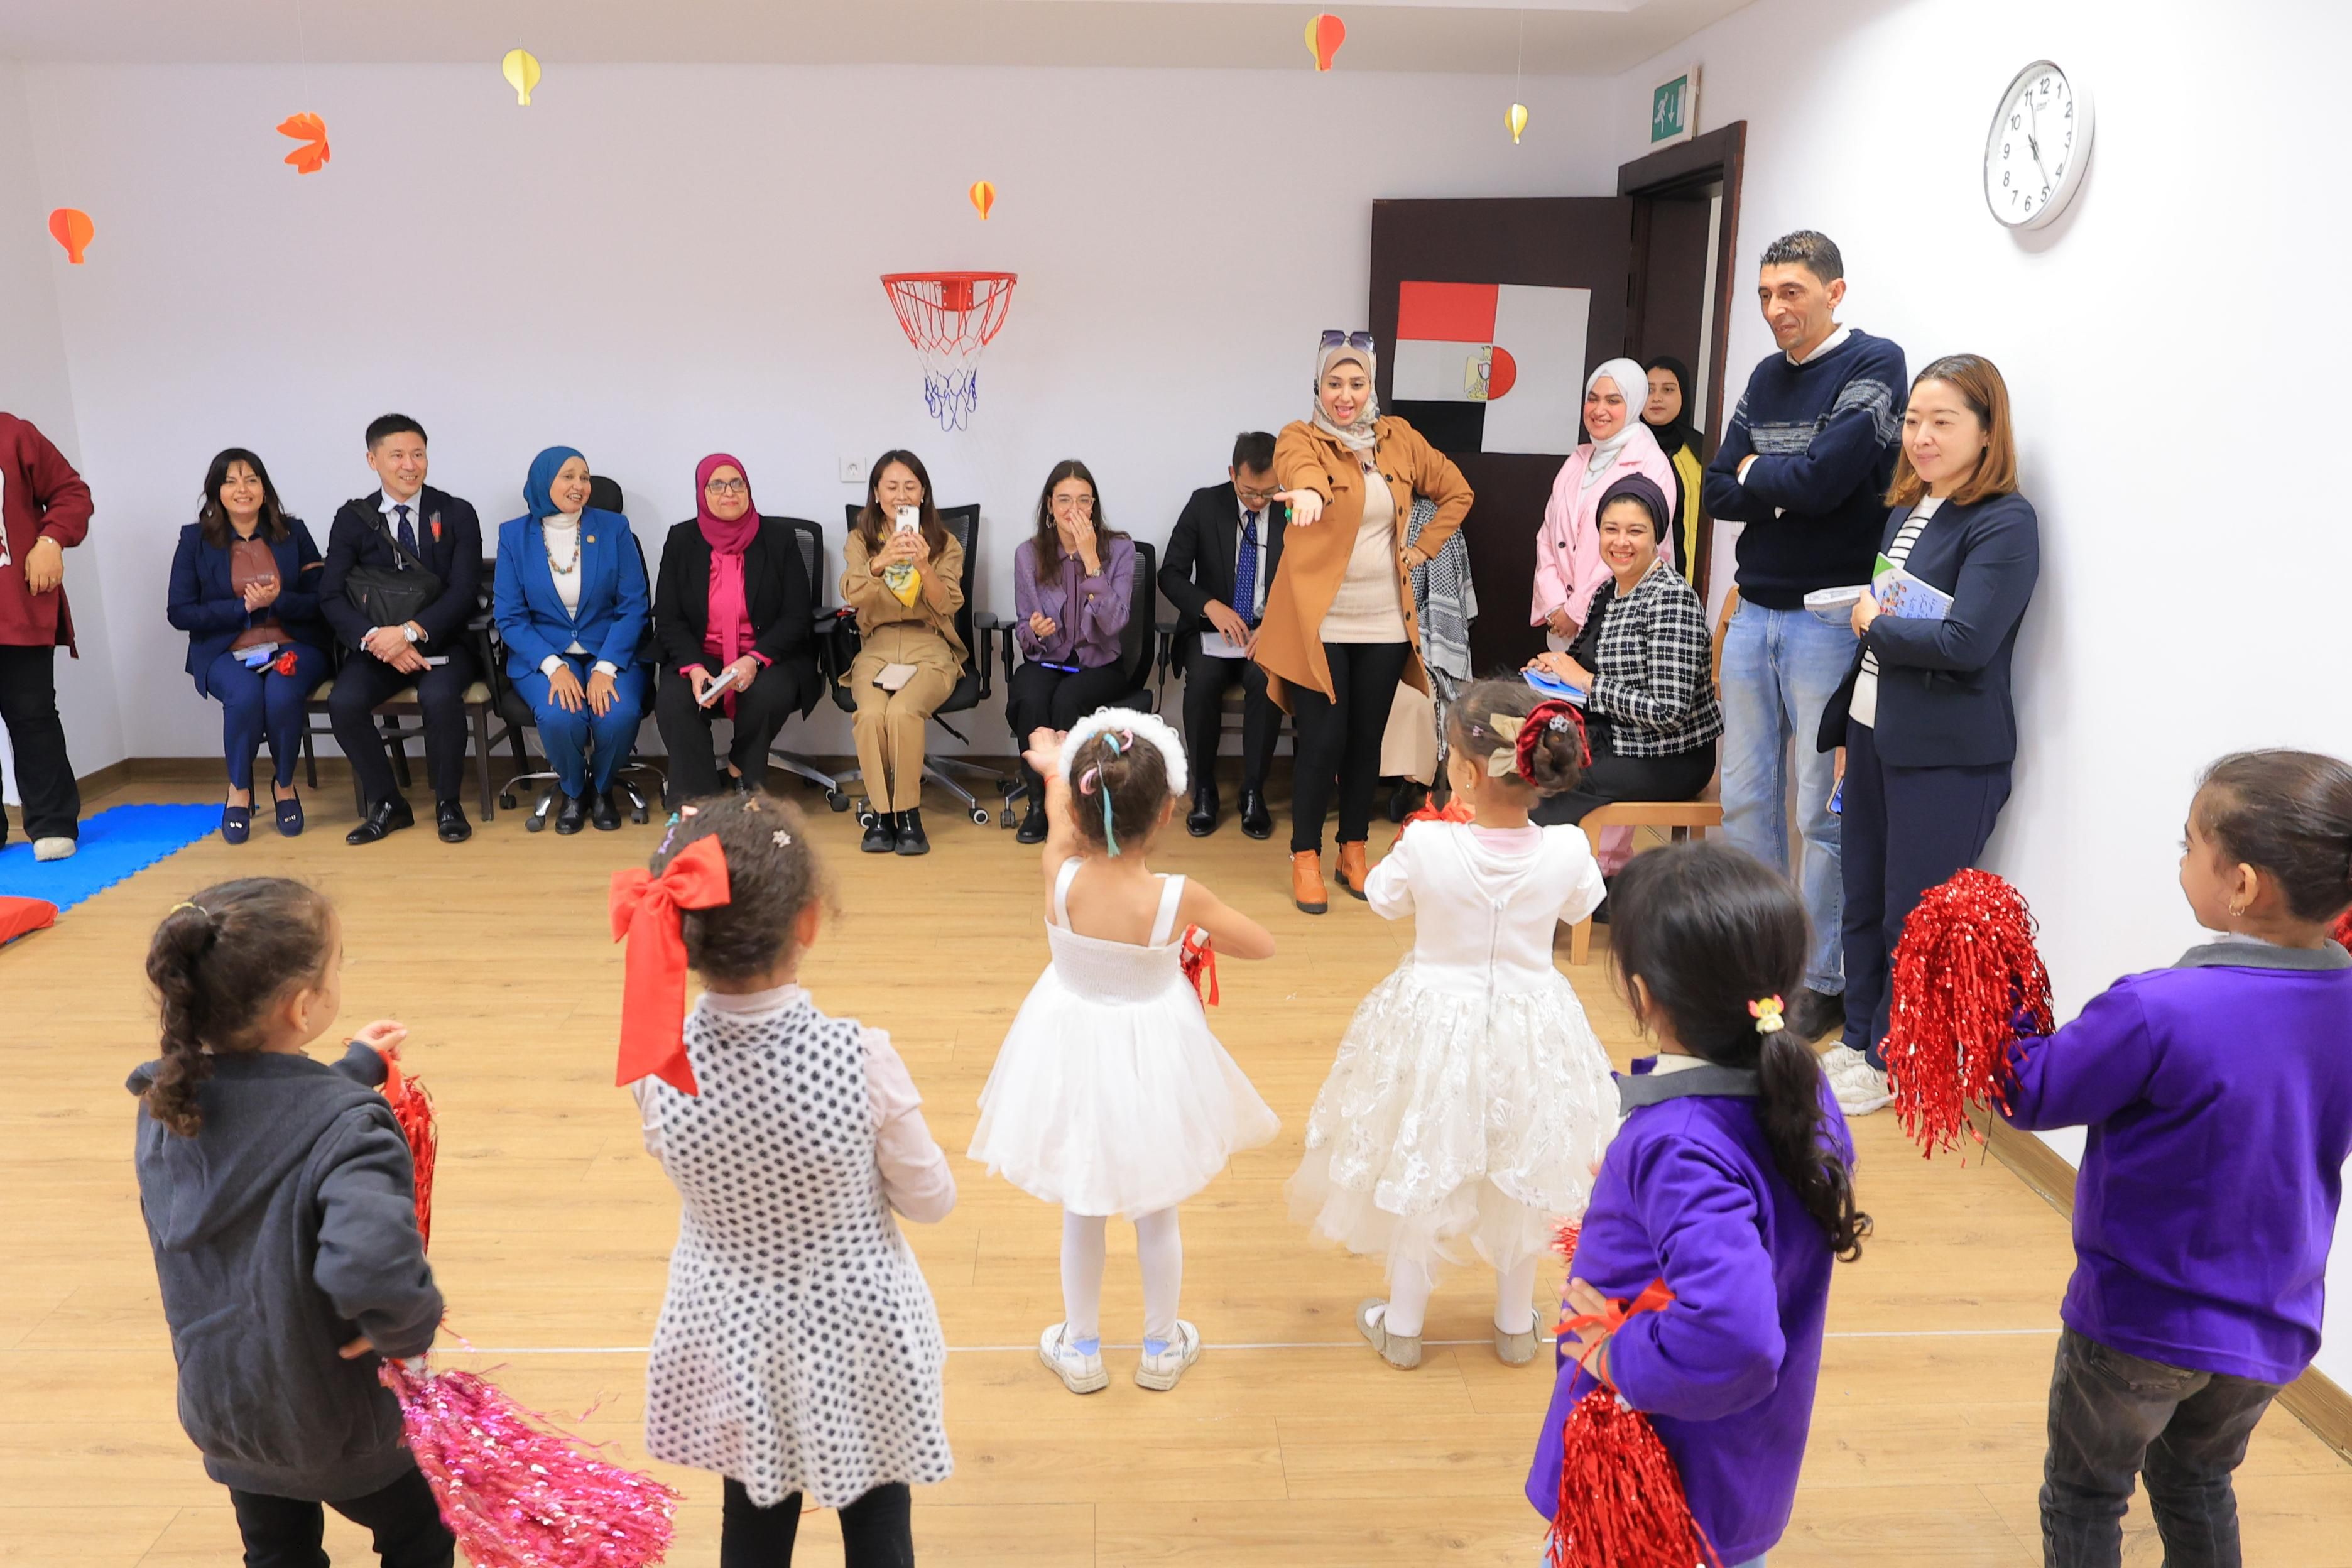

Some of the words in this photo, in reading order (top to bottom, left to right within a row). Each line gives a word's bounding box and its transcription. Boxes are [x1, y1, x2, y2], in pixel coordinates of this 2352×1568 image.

[2040, 77, 2050, 95] 12
[2057, 82, 2062, 99] 1
[2025, 89, 2033, 106] 11
[2064, 101, 2071, 118] 2
[2011, 114, 2021, 131] 10
[2065, 131, 2071, 148] 3
[2003, 143, 2010, 160] 9
[2055, 163, 2062, 177] 4
[2003, 171, 2010, 187] 8
[2012, 190, 2018, 205] 7
[2040, 185, 2049, 202] 5
[2025, 195, 2032, 212] 6
